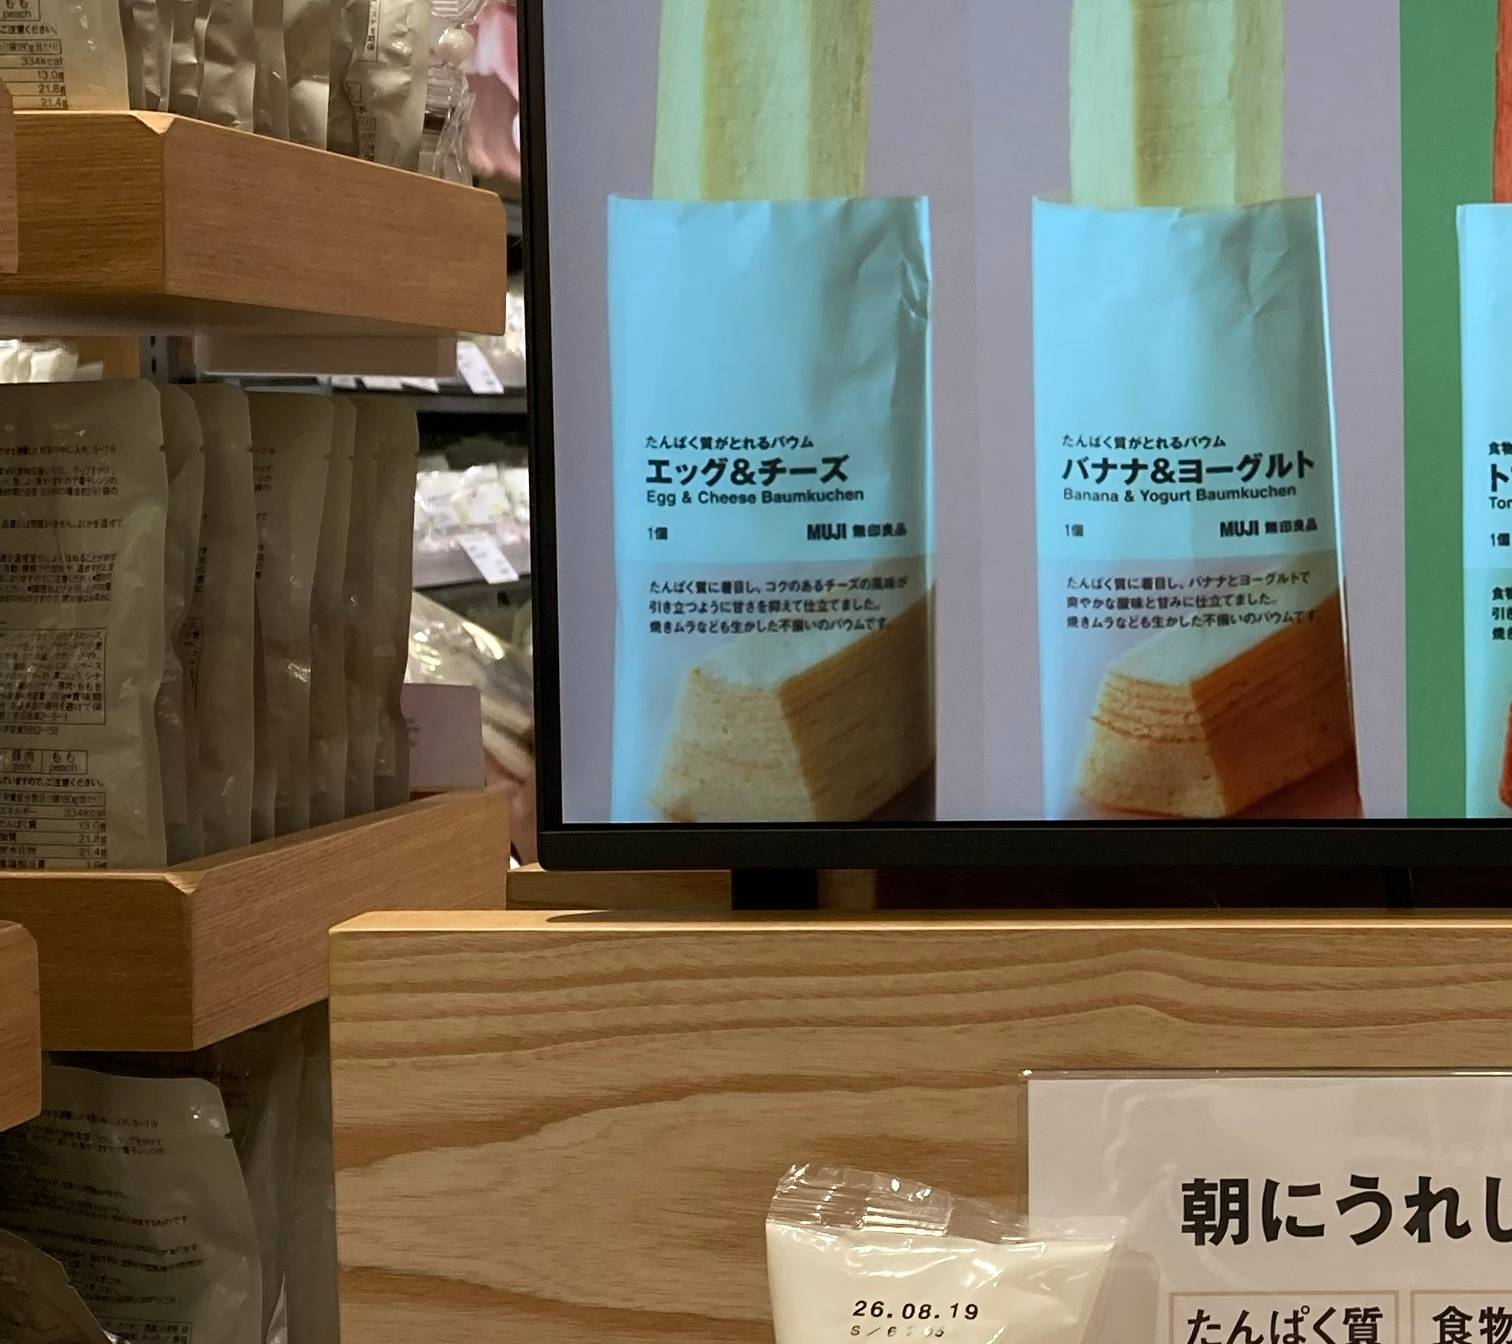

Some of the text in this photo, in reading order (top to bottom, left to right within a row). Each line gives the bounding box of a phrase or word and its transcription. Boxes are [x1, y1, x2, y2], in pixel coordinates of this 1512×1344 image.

[646, 454, 850, 487] エッグ&チーズ
[1062, 450, 1315, 485] バナナ&ヨーグルト
[646, 488, 864, 507] Egg & Cheese Baumkuchen
[1063, 485, 1296, 505] Banana & Yogurt Baumkuchen
[648, 527, 668, 540] 1個
[807, 523, 907, 541] MUJI 無印良品
[1065, 524, 1084, 537] 1個
[1220, 519, 1318, 538] MUJI 無印良品
[1490, 533, 1510, 547] 1個
[853, 1300, 979, 1321] 26.08.19
